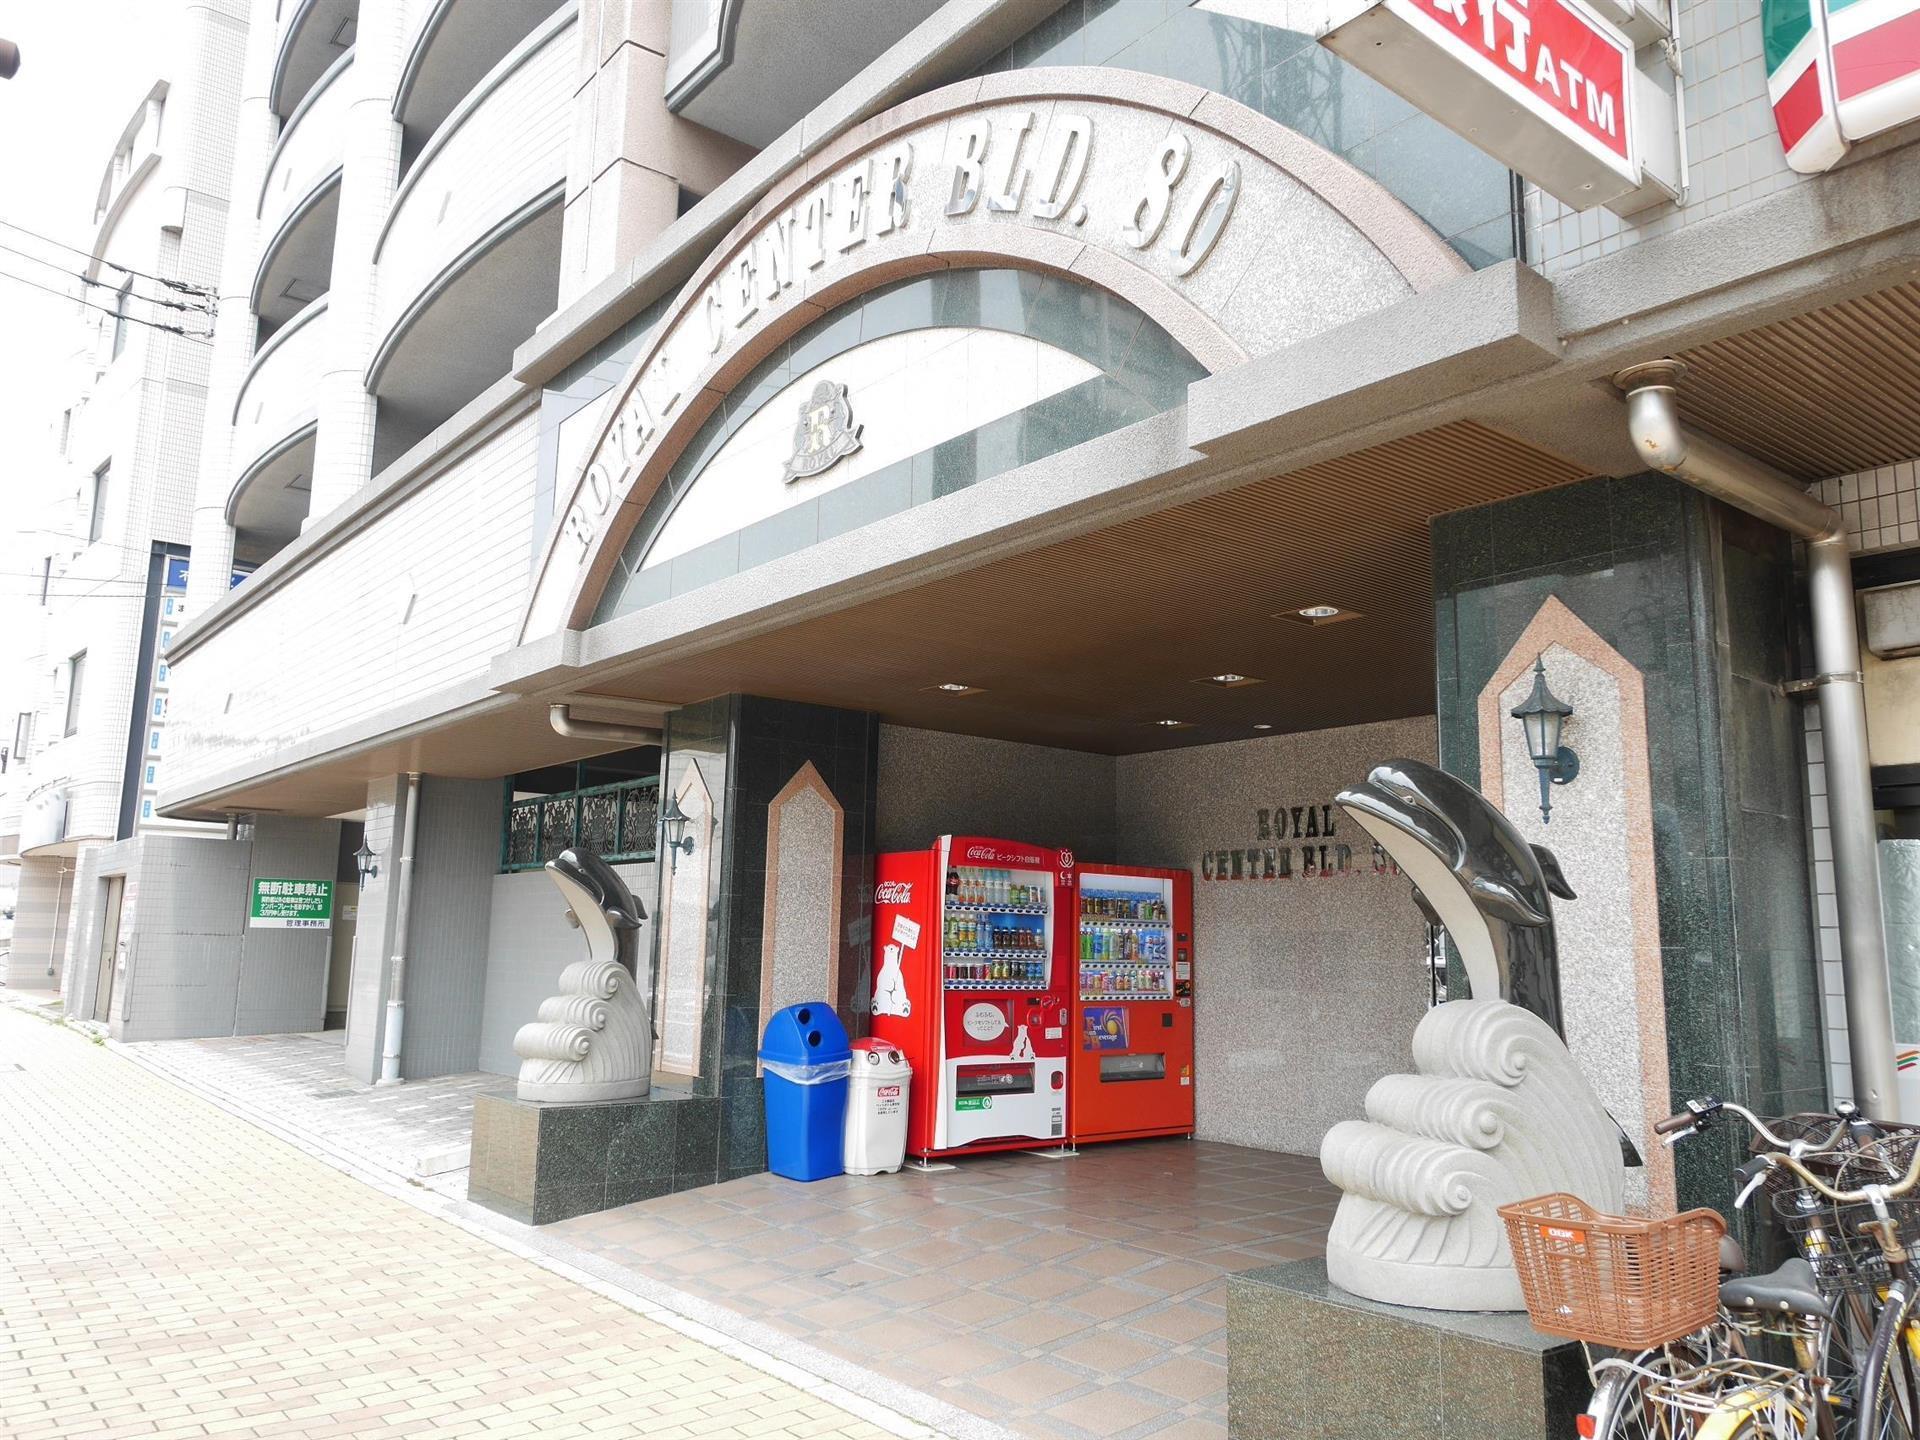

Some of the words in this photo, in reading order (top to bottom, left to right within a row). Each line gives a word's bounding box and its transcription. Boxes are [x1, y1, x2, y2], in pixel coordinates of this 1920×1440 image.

[1433, 0, 1616, 137] 行ATM
[564, 352, 682, 567] ROYAL
[702, 140, 915, 358] CENTER
[943, 111, 1094, 227] BLD.
[1124, 132, 1242, 279] 80
[1257, 804, 1335, 841] ROYAL
[1201, 848, 1292, 882] CENTER
[258, 881, 329, 897] 無断駐車禁止
